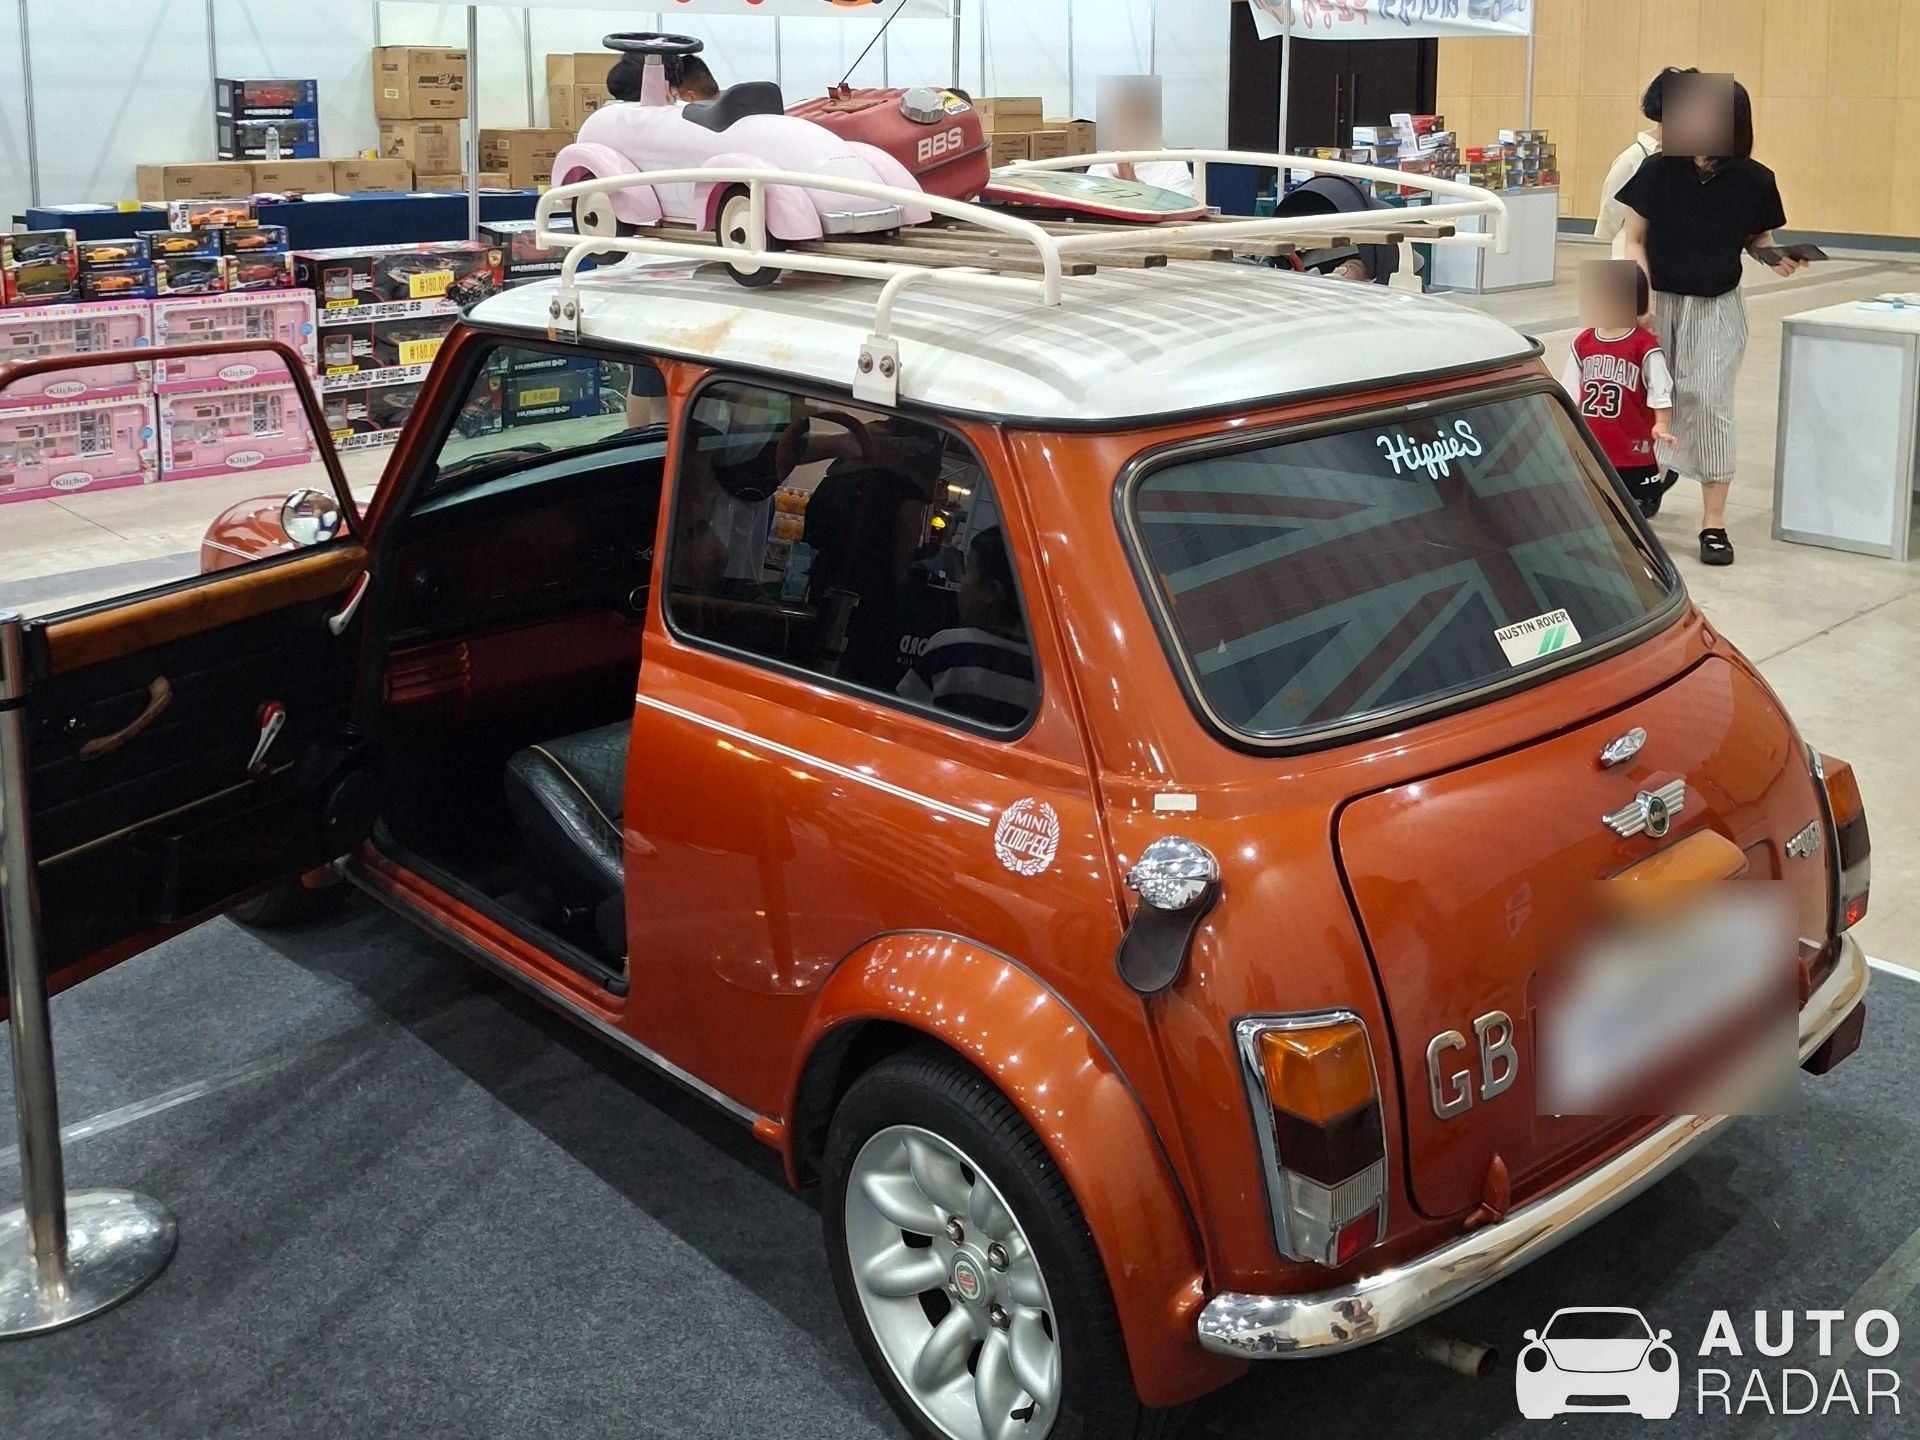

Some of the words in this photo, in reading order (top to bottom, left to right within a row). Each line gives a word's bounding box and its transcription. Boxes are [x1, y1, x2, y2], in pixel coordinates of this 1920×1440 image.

[917, 126, 962, 162] BBS
[510, 263, 549, 272] HUMMER
[375, 301, 422, 315] VEHICLES
[514, 360, 552, 370] HUMMER
[220, 367, 255, 378] Kitchen
[375, 366, 422, 380] VEHICLES
[1582, 354, 1640, 392] ORDAN
[46, 384, 84, 396] Kitchen
[1581, 381, 1622, 419] 23
[516, 407, 555, 418] HUMMER
[370, 430, 399, 443] VEHIC
[227, 453, 262, 465] Kitchen
[53, 475, 90, 487] Kitchen
[1497, 621, 1536, 643] AUSTIN
[1535, 611, 1569, 629] ROVER
[1014, 810, 1049, 834] MINI
[1000, 825, 1051, 860] COOPER
[1426, 1009, 1519, 1120] GB
